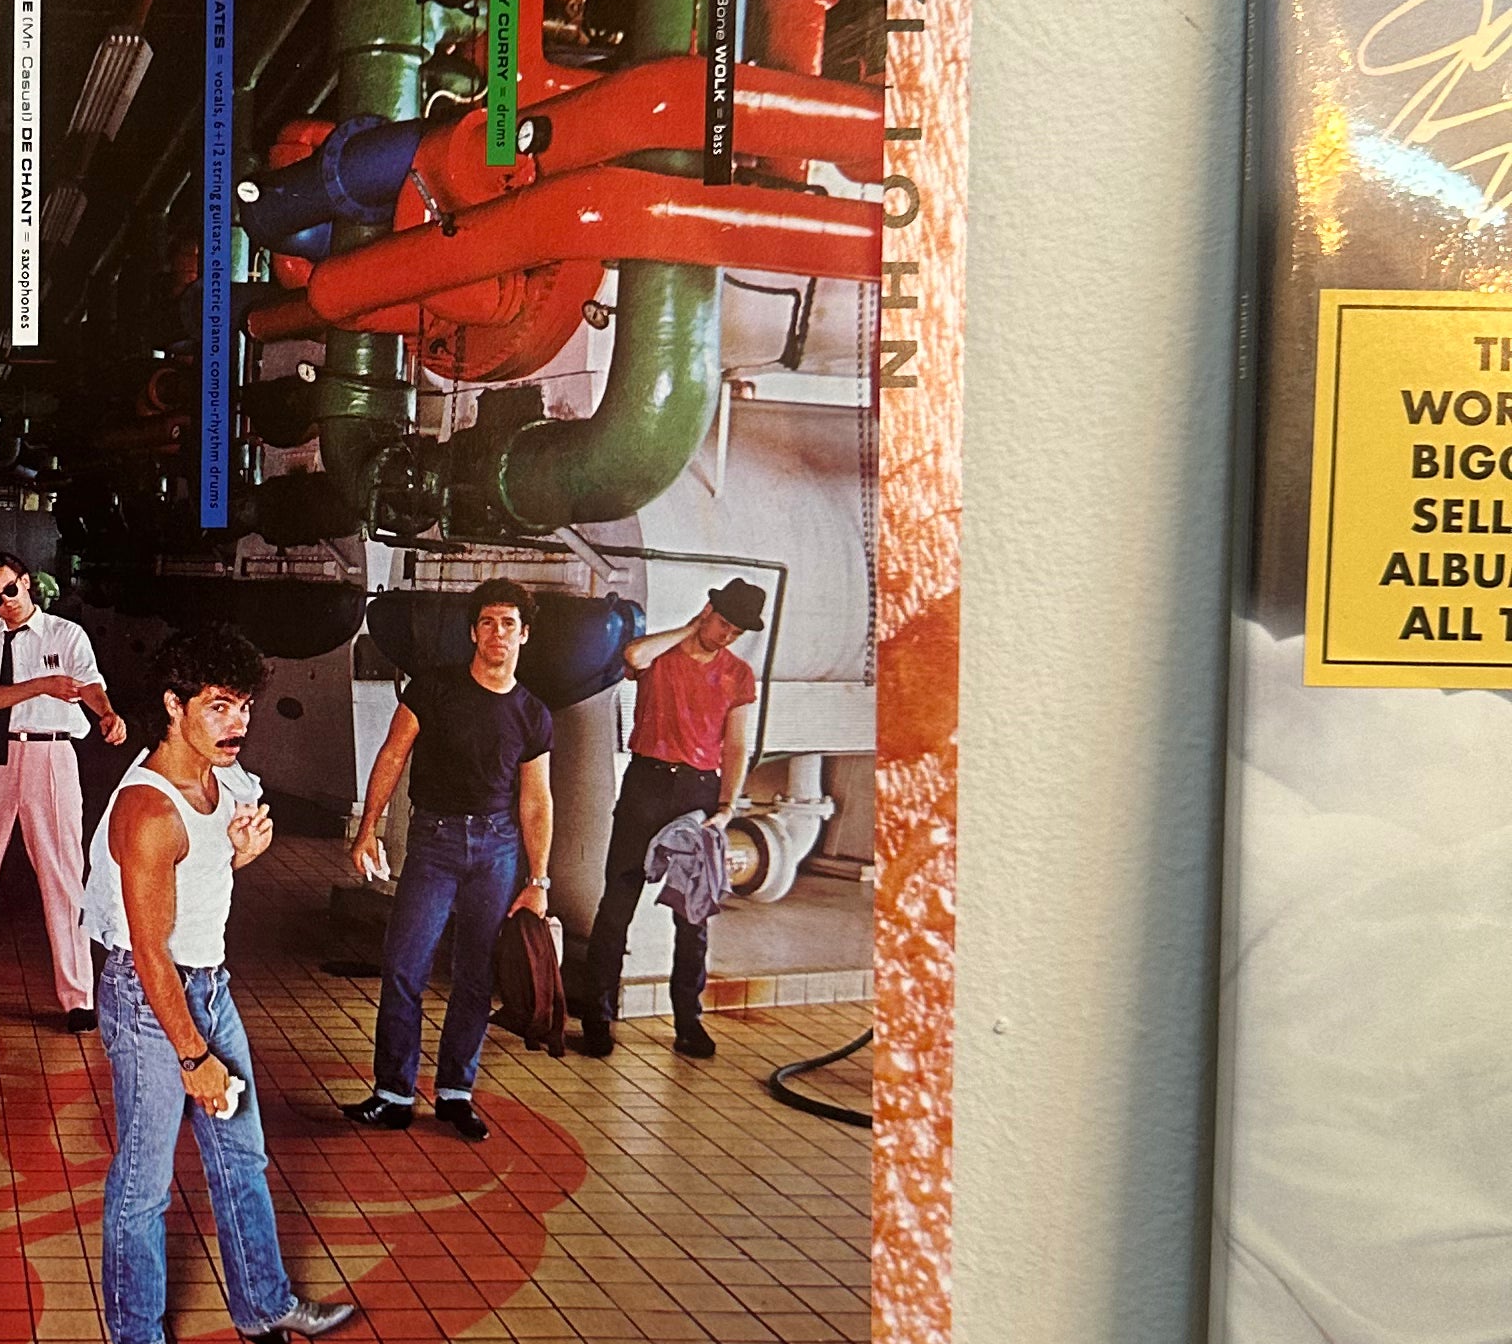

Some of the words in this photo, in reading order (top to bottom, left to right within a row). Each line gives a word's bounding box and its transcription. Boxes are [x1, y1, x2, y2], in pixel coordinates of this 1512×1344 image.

[497, 13, 510, 81] CURRY
[21, 57, 34, 123] Casual)
[212, 71, 226, 117] vocals,
[713, 45, 727, 103] WOLK
[21, 128, 33, 153] DE
[212, 122, 226, 156] 6+12
[496, 104, 510, 148] drums
[712, 125, 726, 156] bass
[20, 158, 33, 227] CHANT
[208, 160, 225, 201] string
[208, 204, 222, 256] guitars,
[17, 249, 32, 329] saxophones
[211, 260, 224, 313] electric
[208, 316, 223, 357] piano,
[207, 361, 223, 463] compu-rhythm
[209, 466, 222, 509] drums
[1379, 552, 1512, 588] ALBU
[1399, 606, 1483, 641] ALL
